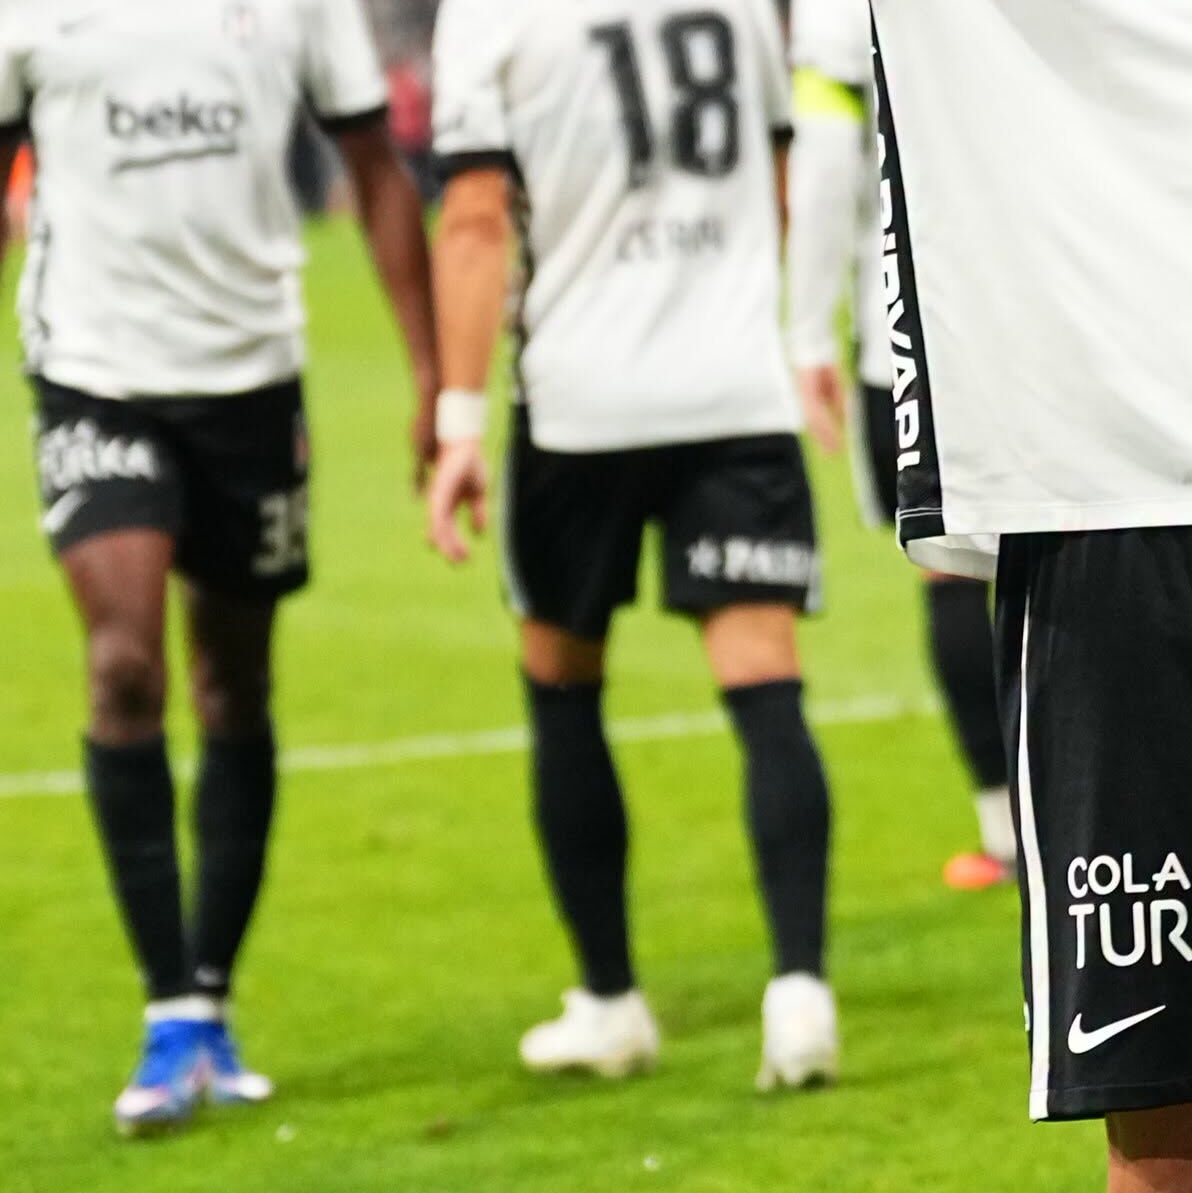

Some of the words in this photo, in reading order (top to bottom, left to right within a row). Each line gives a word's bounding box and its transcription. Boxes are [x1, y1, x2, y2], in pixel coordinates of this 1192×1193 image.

[105, 92, 242, 140] beko
[588, 9, 742, 190] 18
[1067, 852, 1191, 899] COLA
